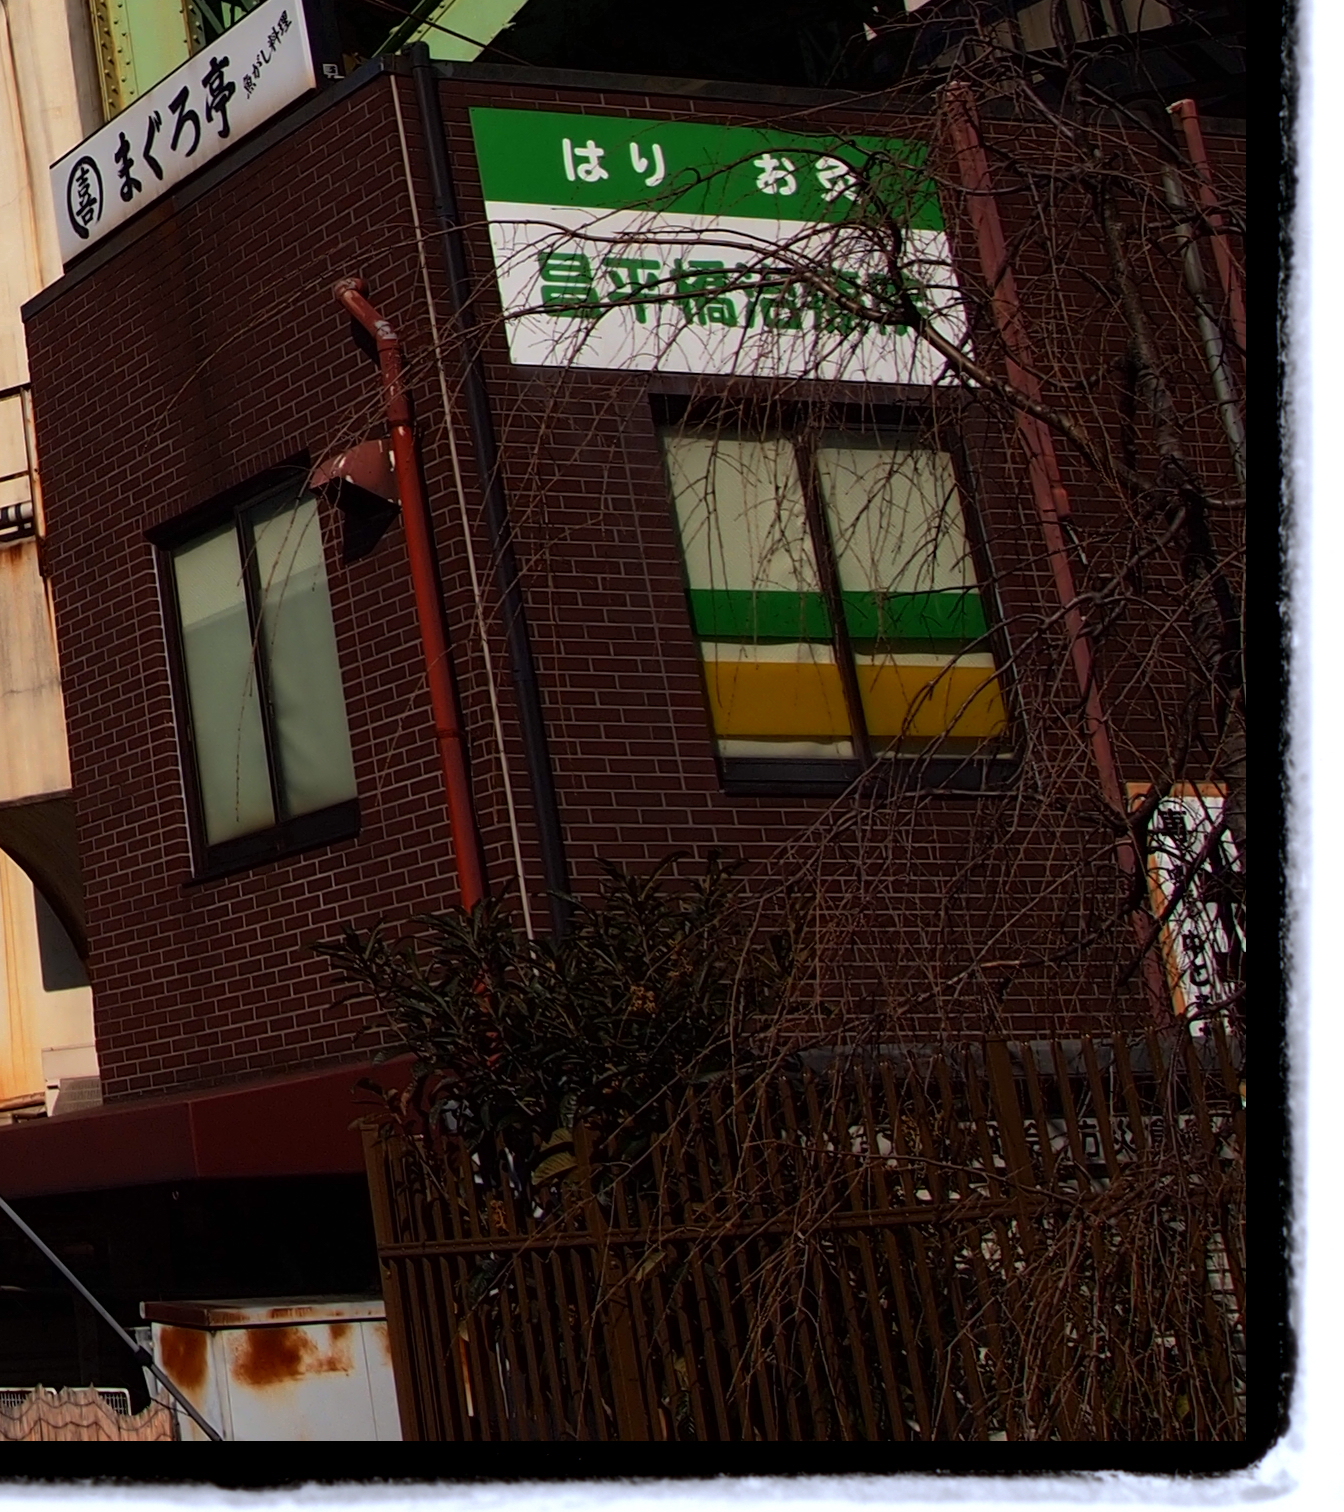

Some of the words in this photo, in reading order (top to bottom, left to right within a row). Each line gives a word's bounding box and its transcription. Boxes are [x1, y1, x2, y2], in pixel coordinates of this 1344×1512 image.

[114, 55, 237, 203] まぐろ亭
[561, 137, 666, 187] はり
